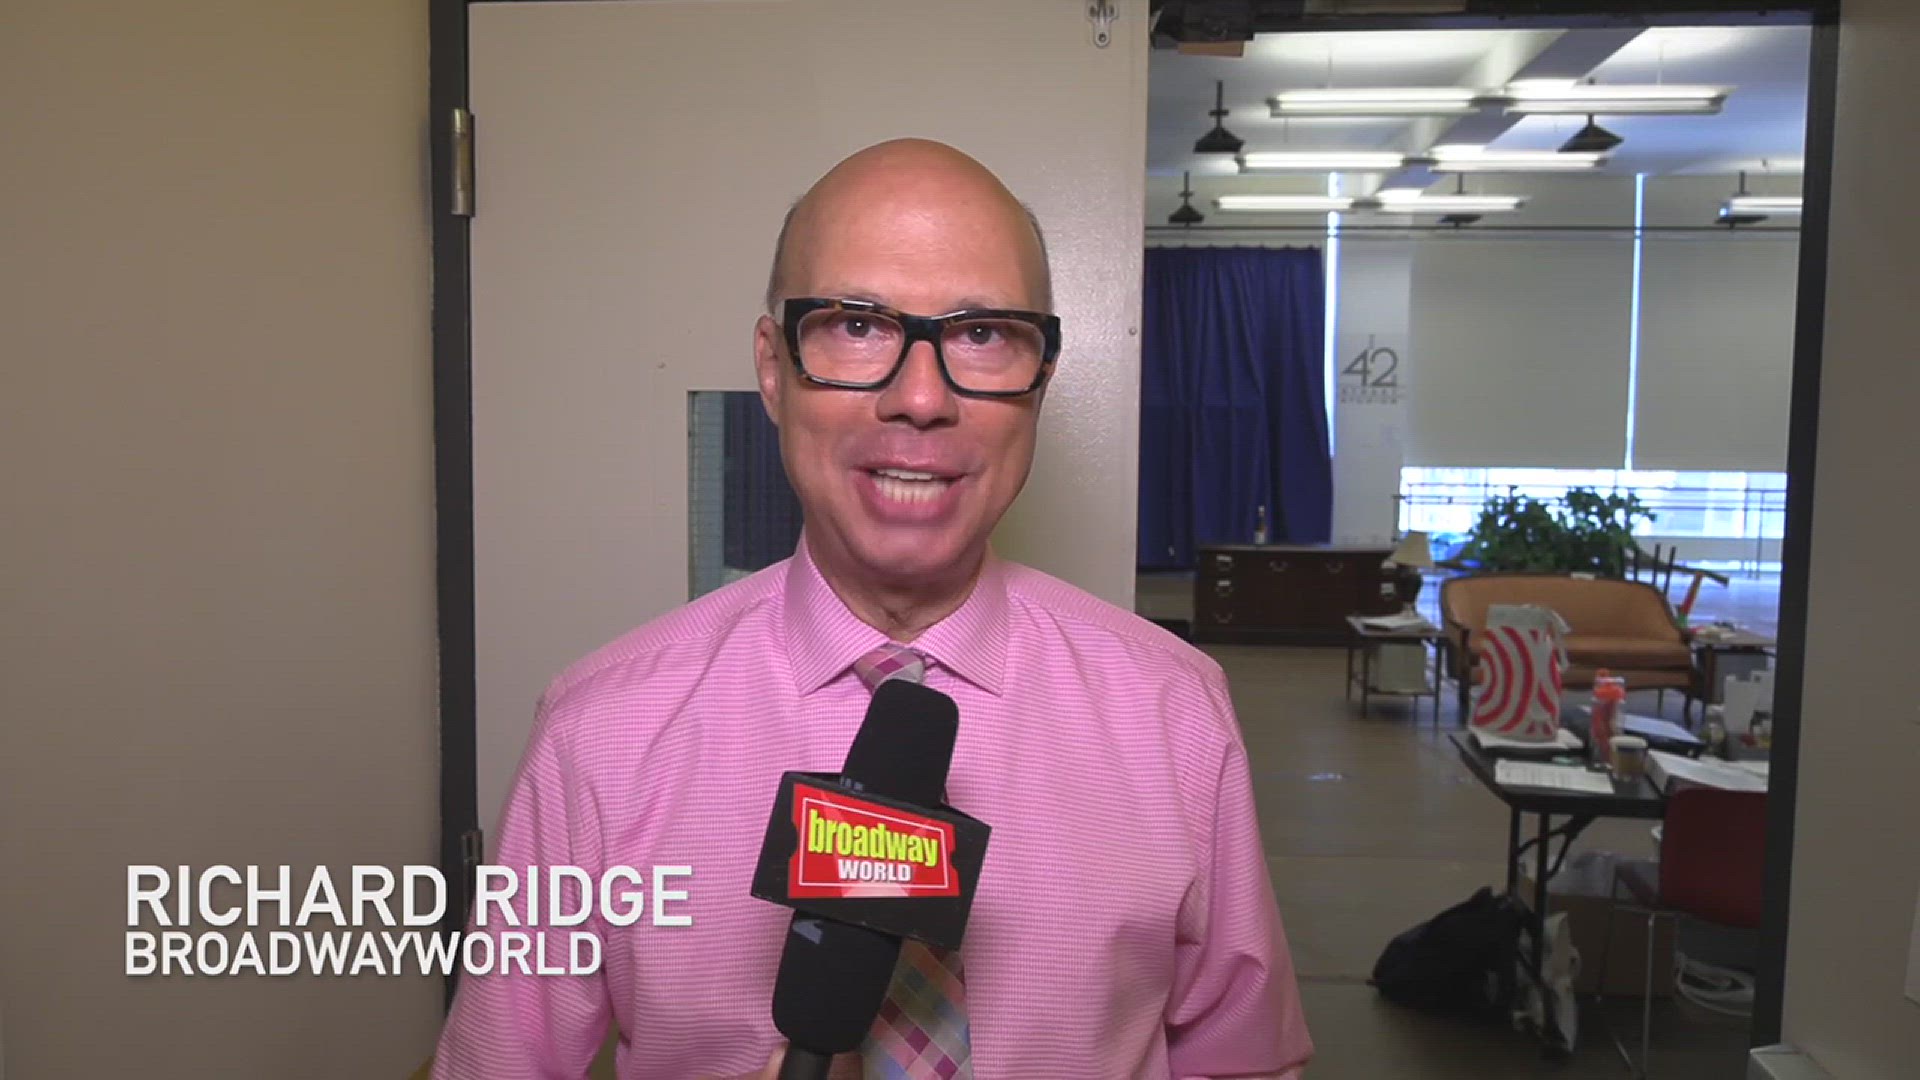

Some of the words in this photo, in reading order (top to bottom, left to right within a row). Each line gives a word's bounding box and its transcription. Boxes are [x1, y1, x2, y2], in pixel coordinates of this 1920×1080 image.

[1342, 347, 1398, 388] 42
[808, 809, 938, 867] broadway
[838, 859, 912, 881] WORLD
